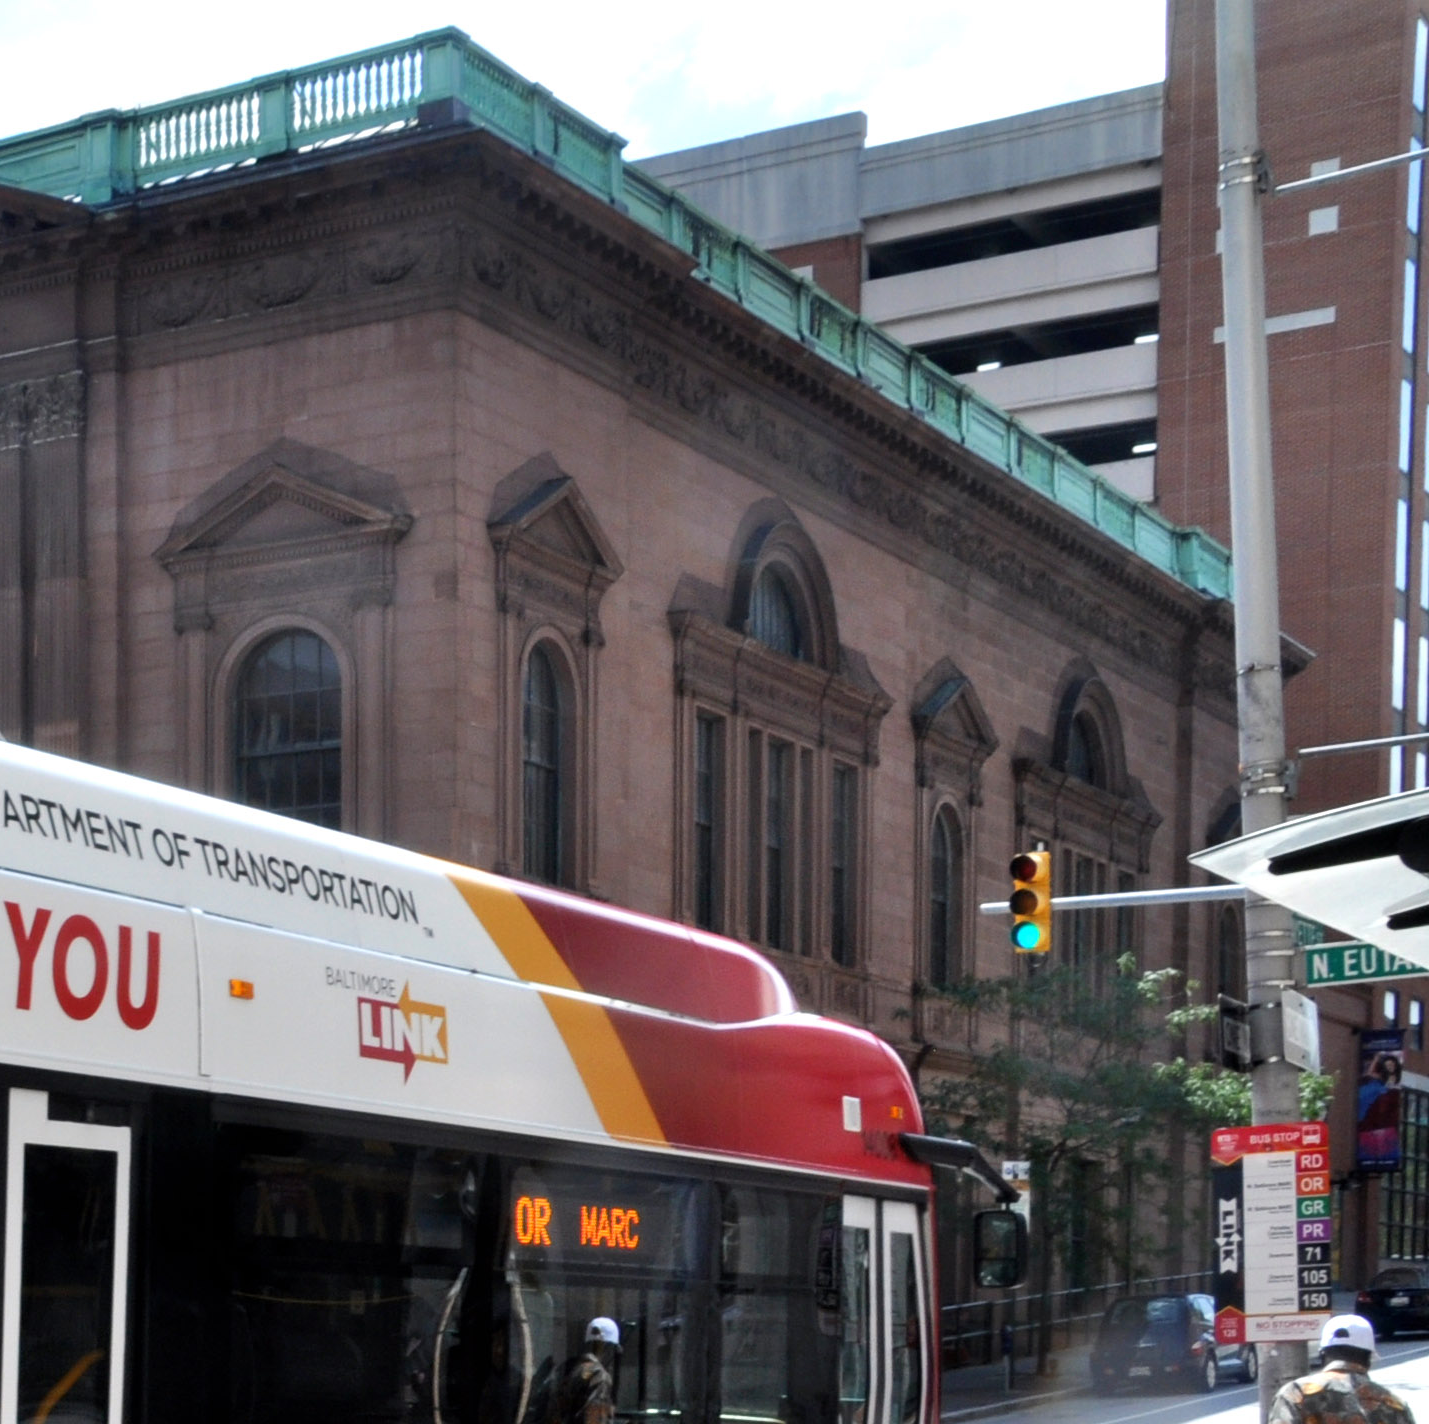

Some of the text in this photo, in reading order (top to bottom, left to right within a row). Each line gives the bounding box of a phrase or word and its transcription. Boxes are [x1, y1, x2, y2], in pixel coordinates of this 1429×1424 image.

[152, 829, 191, 870] OF
[194, 838, 419, 925] TRANSPORTATION
[3, 901, 161, 1031] YOU
[1312, 952, 1335, 980] N.
[325, 965, 397, 998] BALTIMORE
[361, 1001, 447, 1059] LINK
[1249, 1134, 1271, 1145] BUS
[1272, 1131, 1301, 1143] STOP
[1301, 1153, 1324, 1169] RD
[1301, 1176, 1324, 1192] OR
[1302, 1199, 1325, 1216] GR
[515, 1195, 640, 1249] OR MARC
[1302, 1222, 1325, 1239] PR
[1222, 1210, 1235, 1263] LINK
[1304, 1246, 1322, 1262] 71
[1302, 1269, 1328, 1285] 105
[1302, 1292, 1328, 1308] 150
[1255, 1318, 1320, 1330] NO STOPPING
